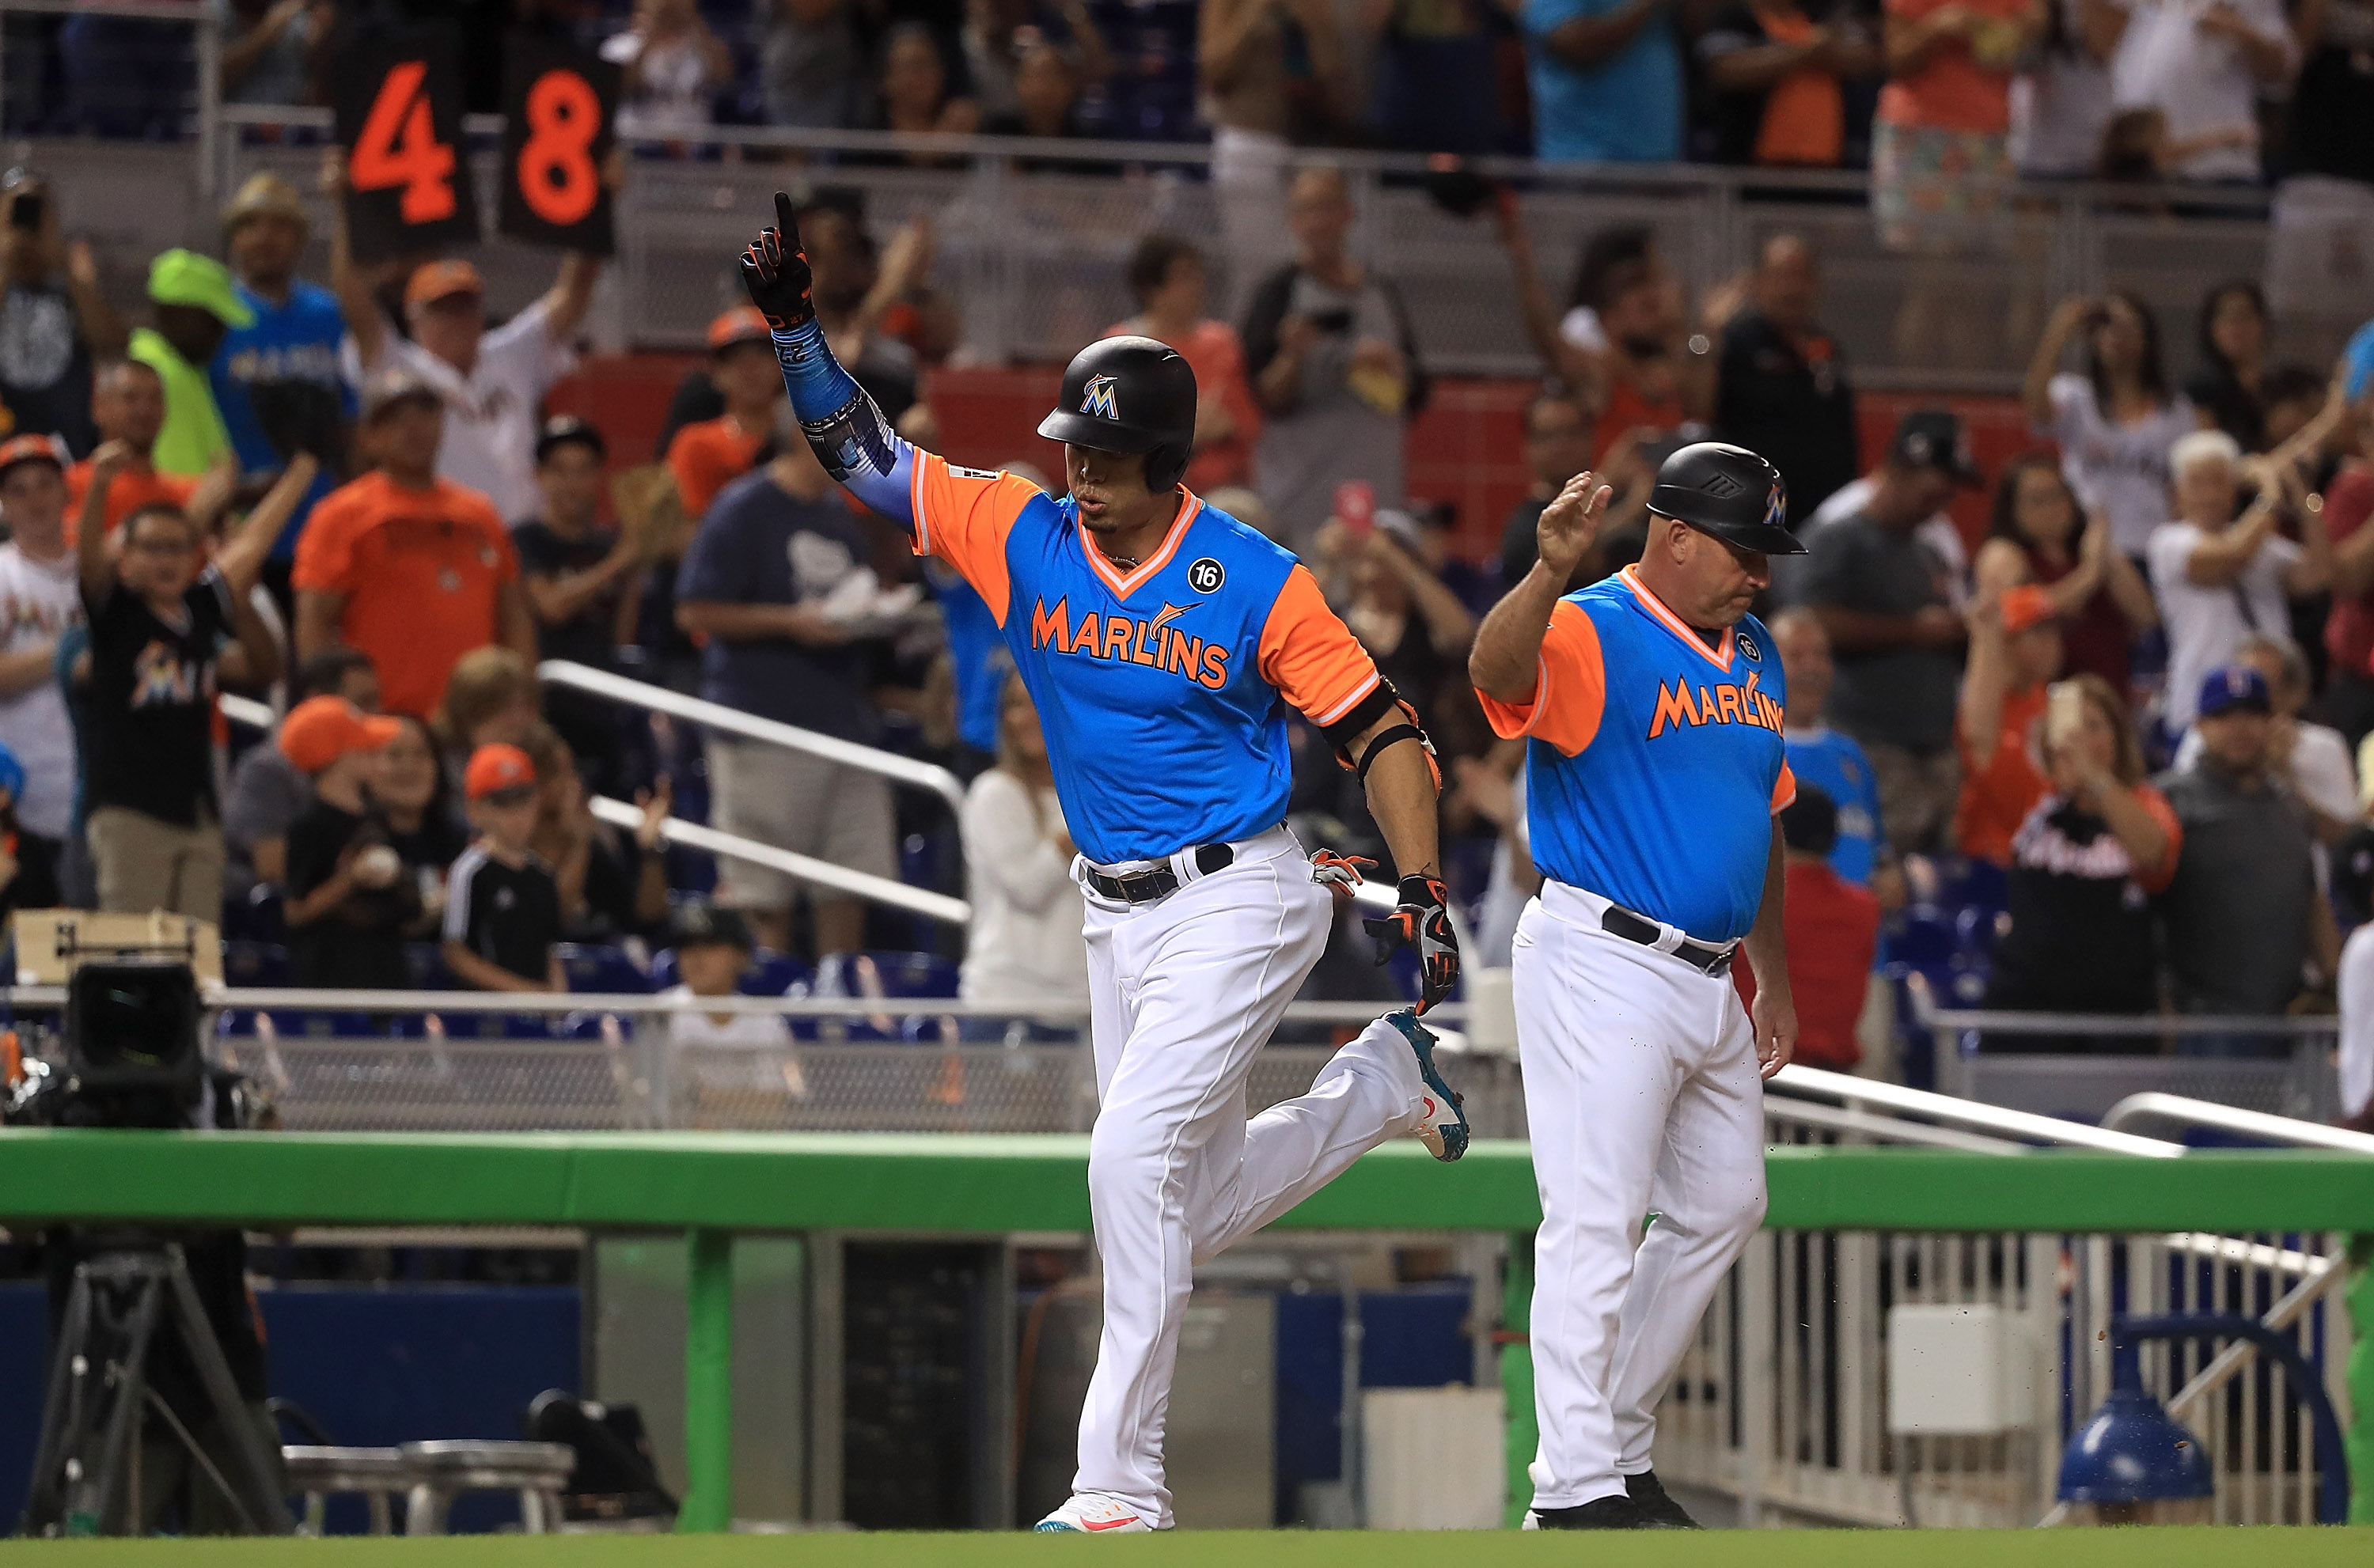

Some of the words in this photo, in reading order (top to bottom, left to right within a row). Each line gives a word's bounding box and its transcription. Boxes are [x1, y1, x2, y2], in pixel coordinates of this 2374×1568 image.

[349, 60, 457, 225] 4
[517, 69, 601, 225] 8
[790, 313, 803, 324] 27
[1196, 564, 1218, 587] 16
[1031, 593, 1231, 690] MARLINS
[1740, 639, 1757, 657] 16
